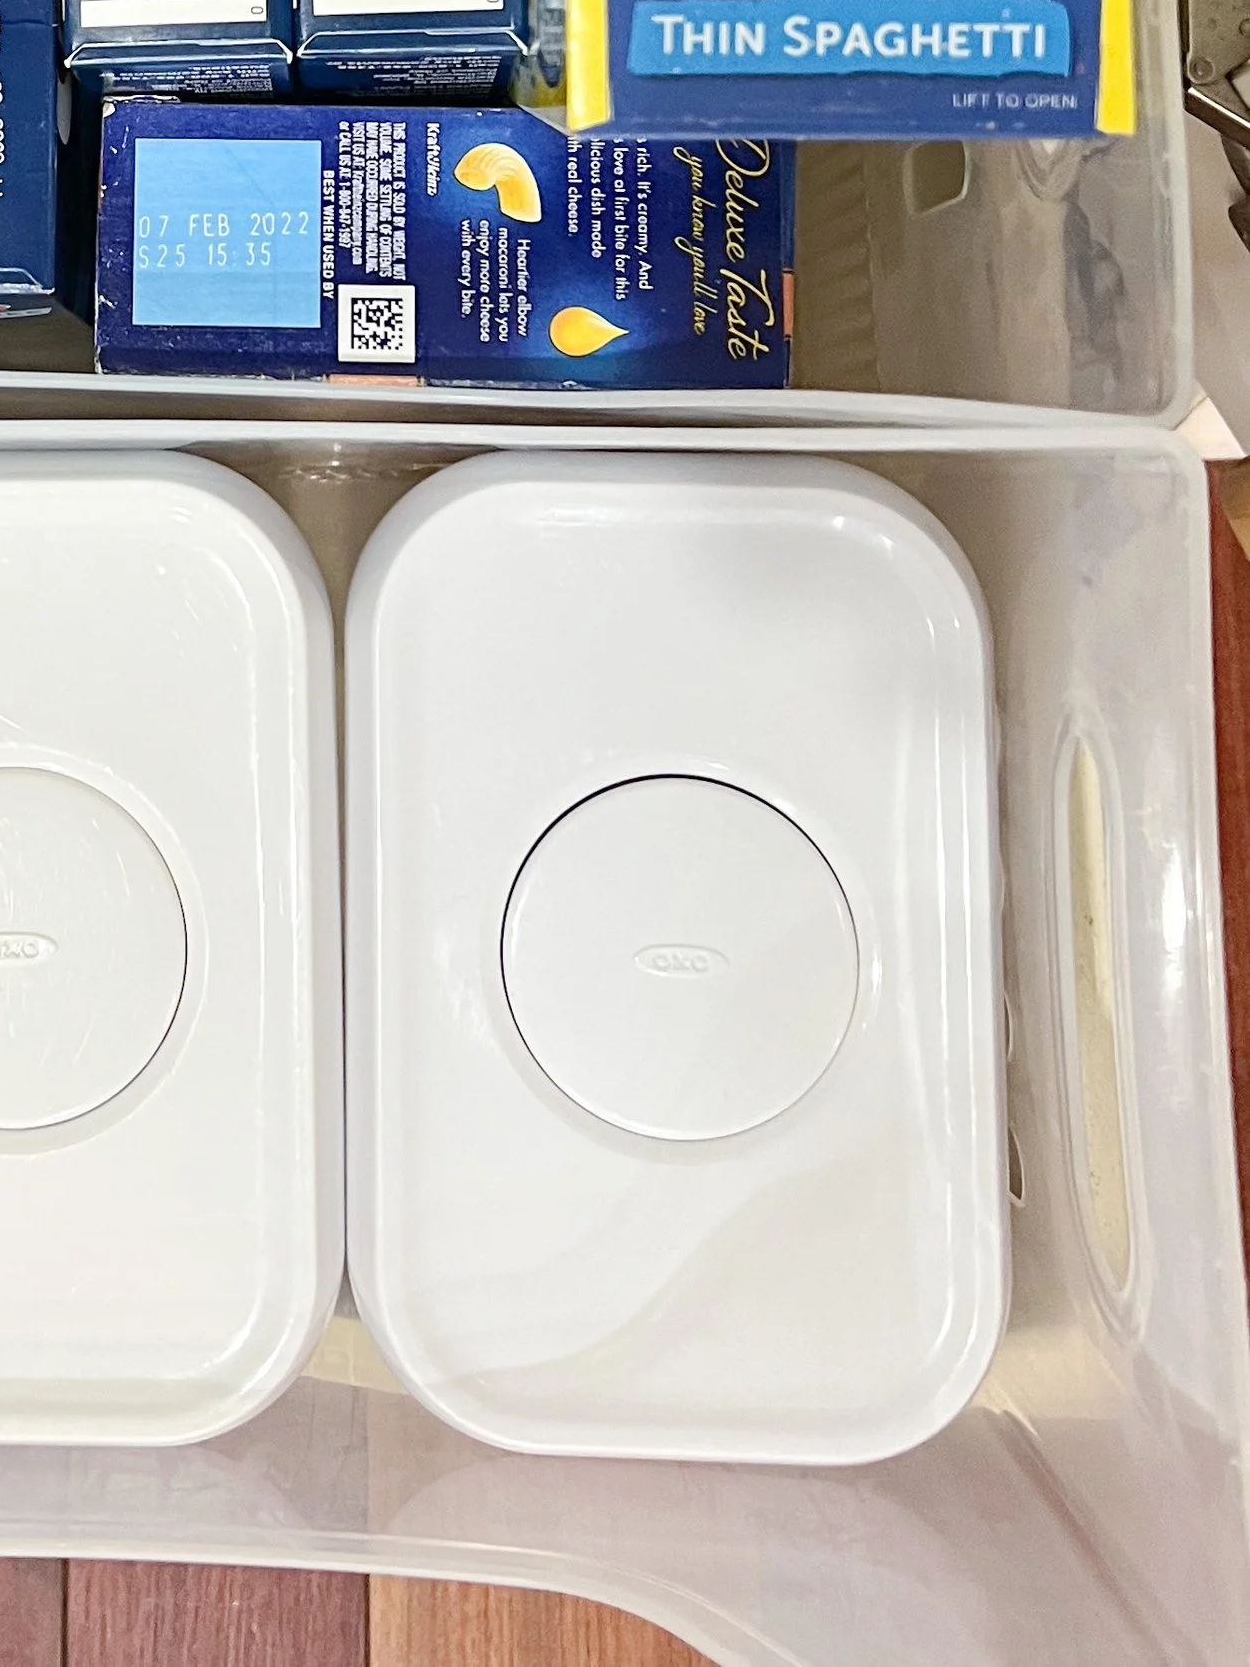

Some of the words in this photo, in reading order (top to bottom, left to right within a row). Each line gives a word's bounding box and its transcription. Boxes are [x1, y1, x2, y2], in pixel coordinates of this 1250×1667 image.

[651, 14, 768, 57] THIN
[783, 16, 1046, 58] SPAGHETTI
[952, 92, 989, 109] LIFT
[996, 93, 1019, 109] TO
[1025, 93, 1076, 110] OPEN
[567, 157, 581, 183] real
[614, 148, 627, 175] love
[323, 170, 334, 202] BEST
[591, 188, 605, 215] dish
[615, 196, 628, 220] first
[715, 139, 771, 263] Deluxe
[139, 215, 169, 238] 07
[189, 214, 230, 237] FEB
[250, 211, 310, 236] 2022
[323, 204, 334, 241] WHEN
[692, 195, 716, 240] know
[461, 219, 475, 248] with
[476, 219, 492, 255] enjoy
[591, 220, 603, 258] made
[615, 225, 628, 249] bite
[138, 244, 186, 269] S25
[323, 244, 334, 279] USED
[498, 227, 512, 288] macaroni
[517, 239, 530, 291] Heartier
[615, 254, 629, 273] for
[615, 277, 629, 300] this
[638, 261, 653, 290] And
[324, 282, 335, 299] BY
[461, 290, 475, 318] bite.
[480, 297, 493, 342] cheese
[494, 317, 508, 342] you
[517, 295, 530, 336] elbow
[693, 302, 717, 335] love
[719, 269, 775, 361] Taste
